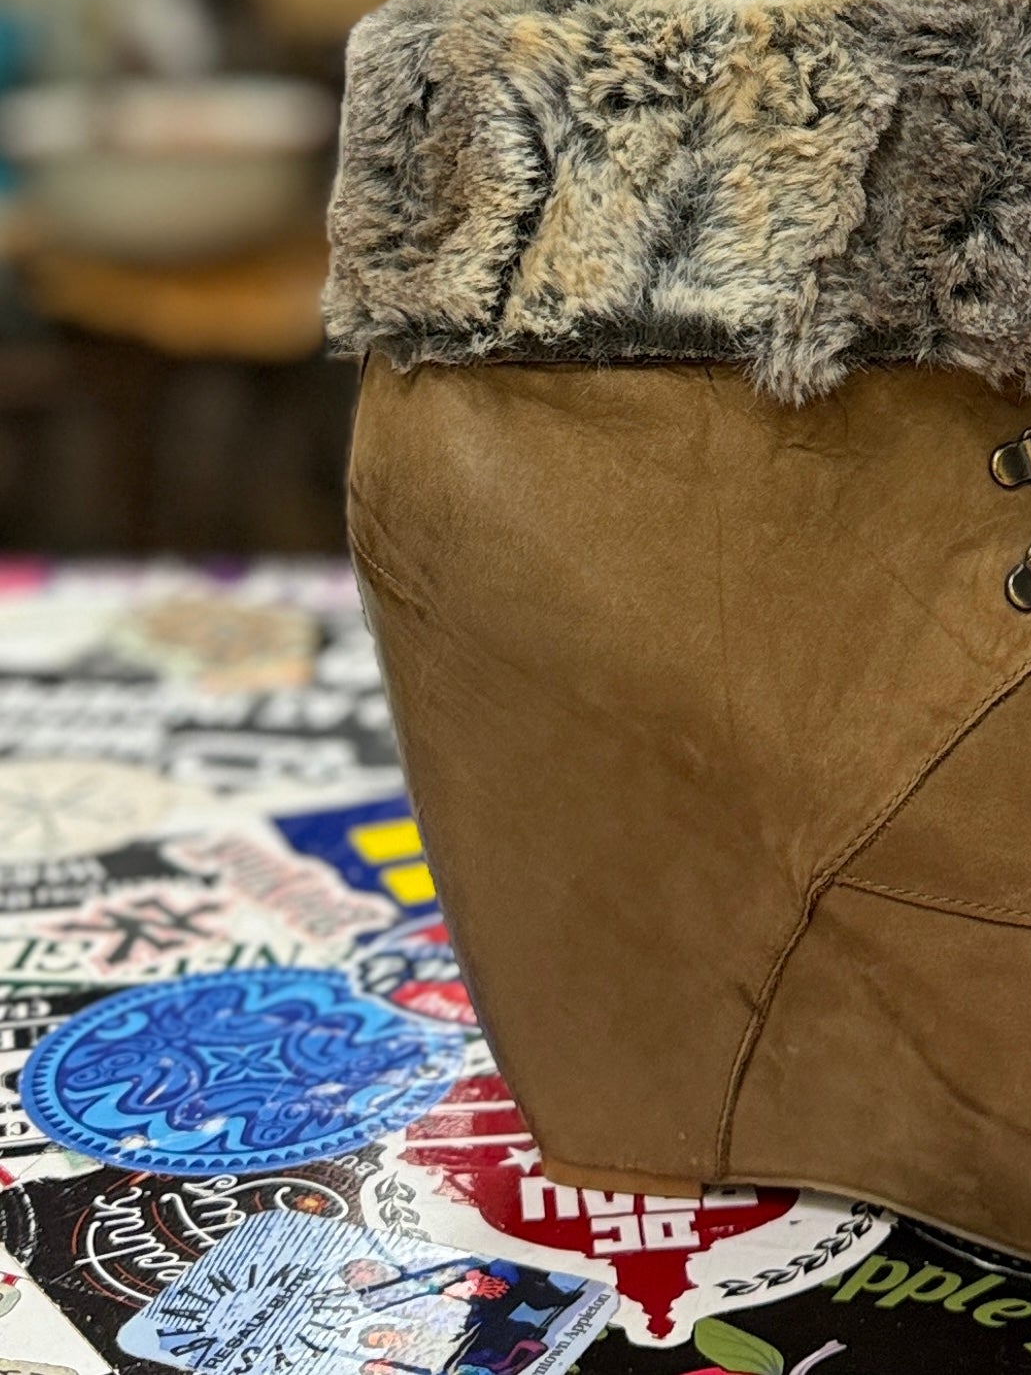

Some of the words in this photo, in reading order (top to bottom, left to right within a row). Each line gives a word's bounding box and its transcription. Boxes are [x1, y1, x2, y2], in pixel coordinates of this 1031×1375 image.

[590, 1210, 700, 1255] DC
[156, 1263, 302, 1357] BEATNIK
[563, 1293, 612, 1340] Appleton
